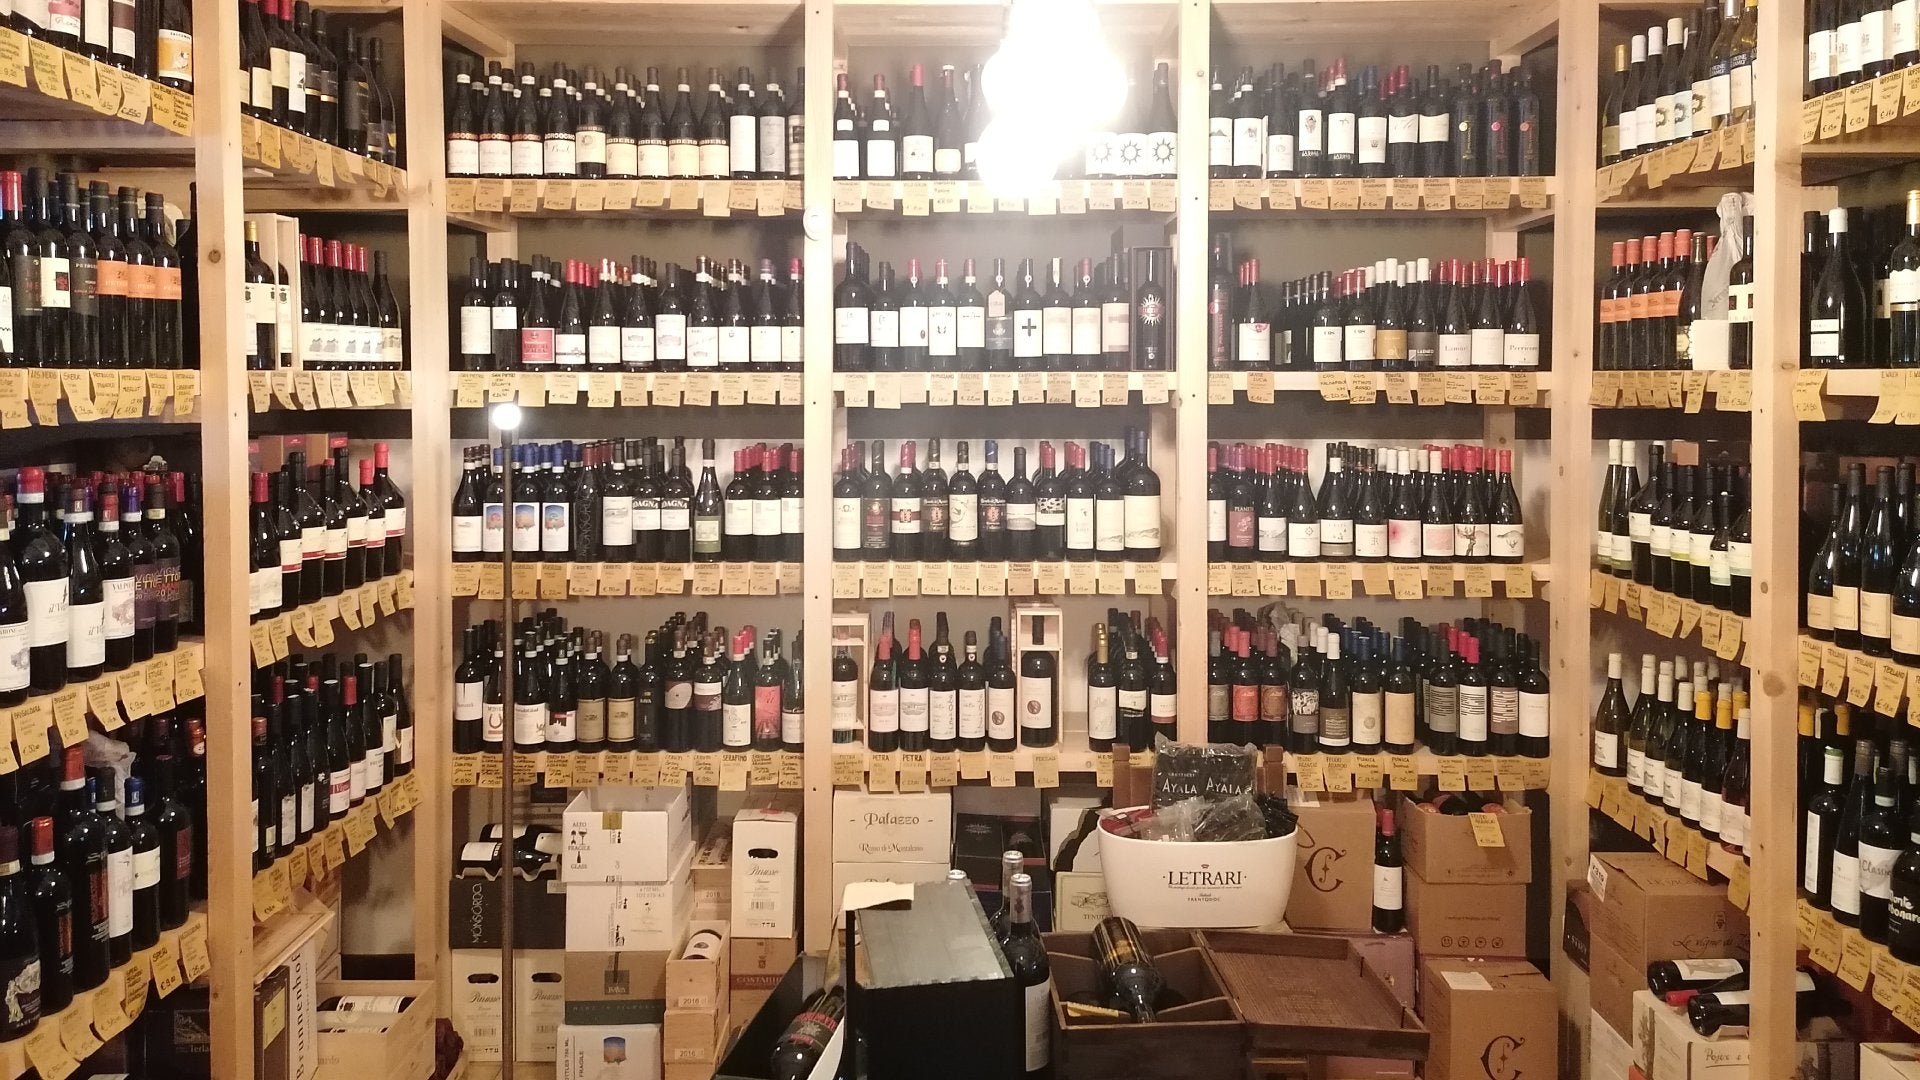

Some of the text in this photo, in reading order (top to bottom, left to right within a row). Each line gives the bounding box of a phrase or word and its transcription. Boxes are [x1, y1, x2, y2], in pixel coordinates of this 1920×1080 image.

[722, 754, 747, 762] SERAFINO
[872, 754, 889, 762] PETRA
[902, 754, 923, 762] PETRA
[1162, 776, 1198, 794] AYALA
[863, 811, 920, 829] Palazzo
[1168, 871, 1242, 886] LETRARI
